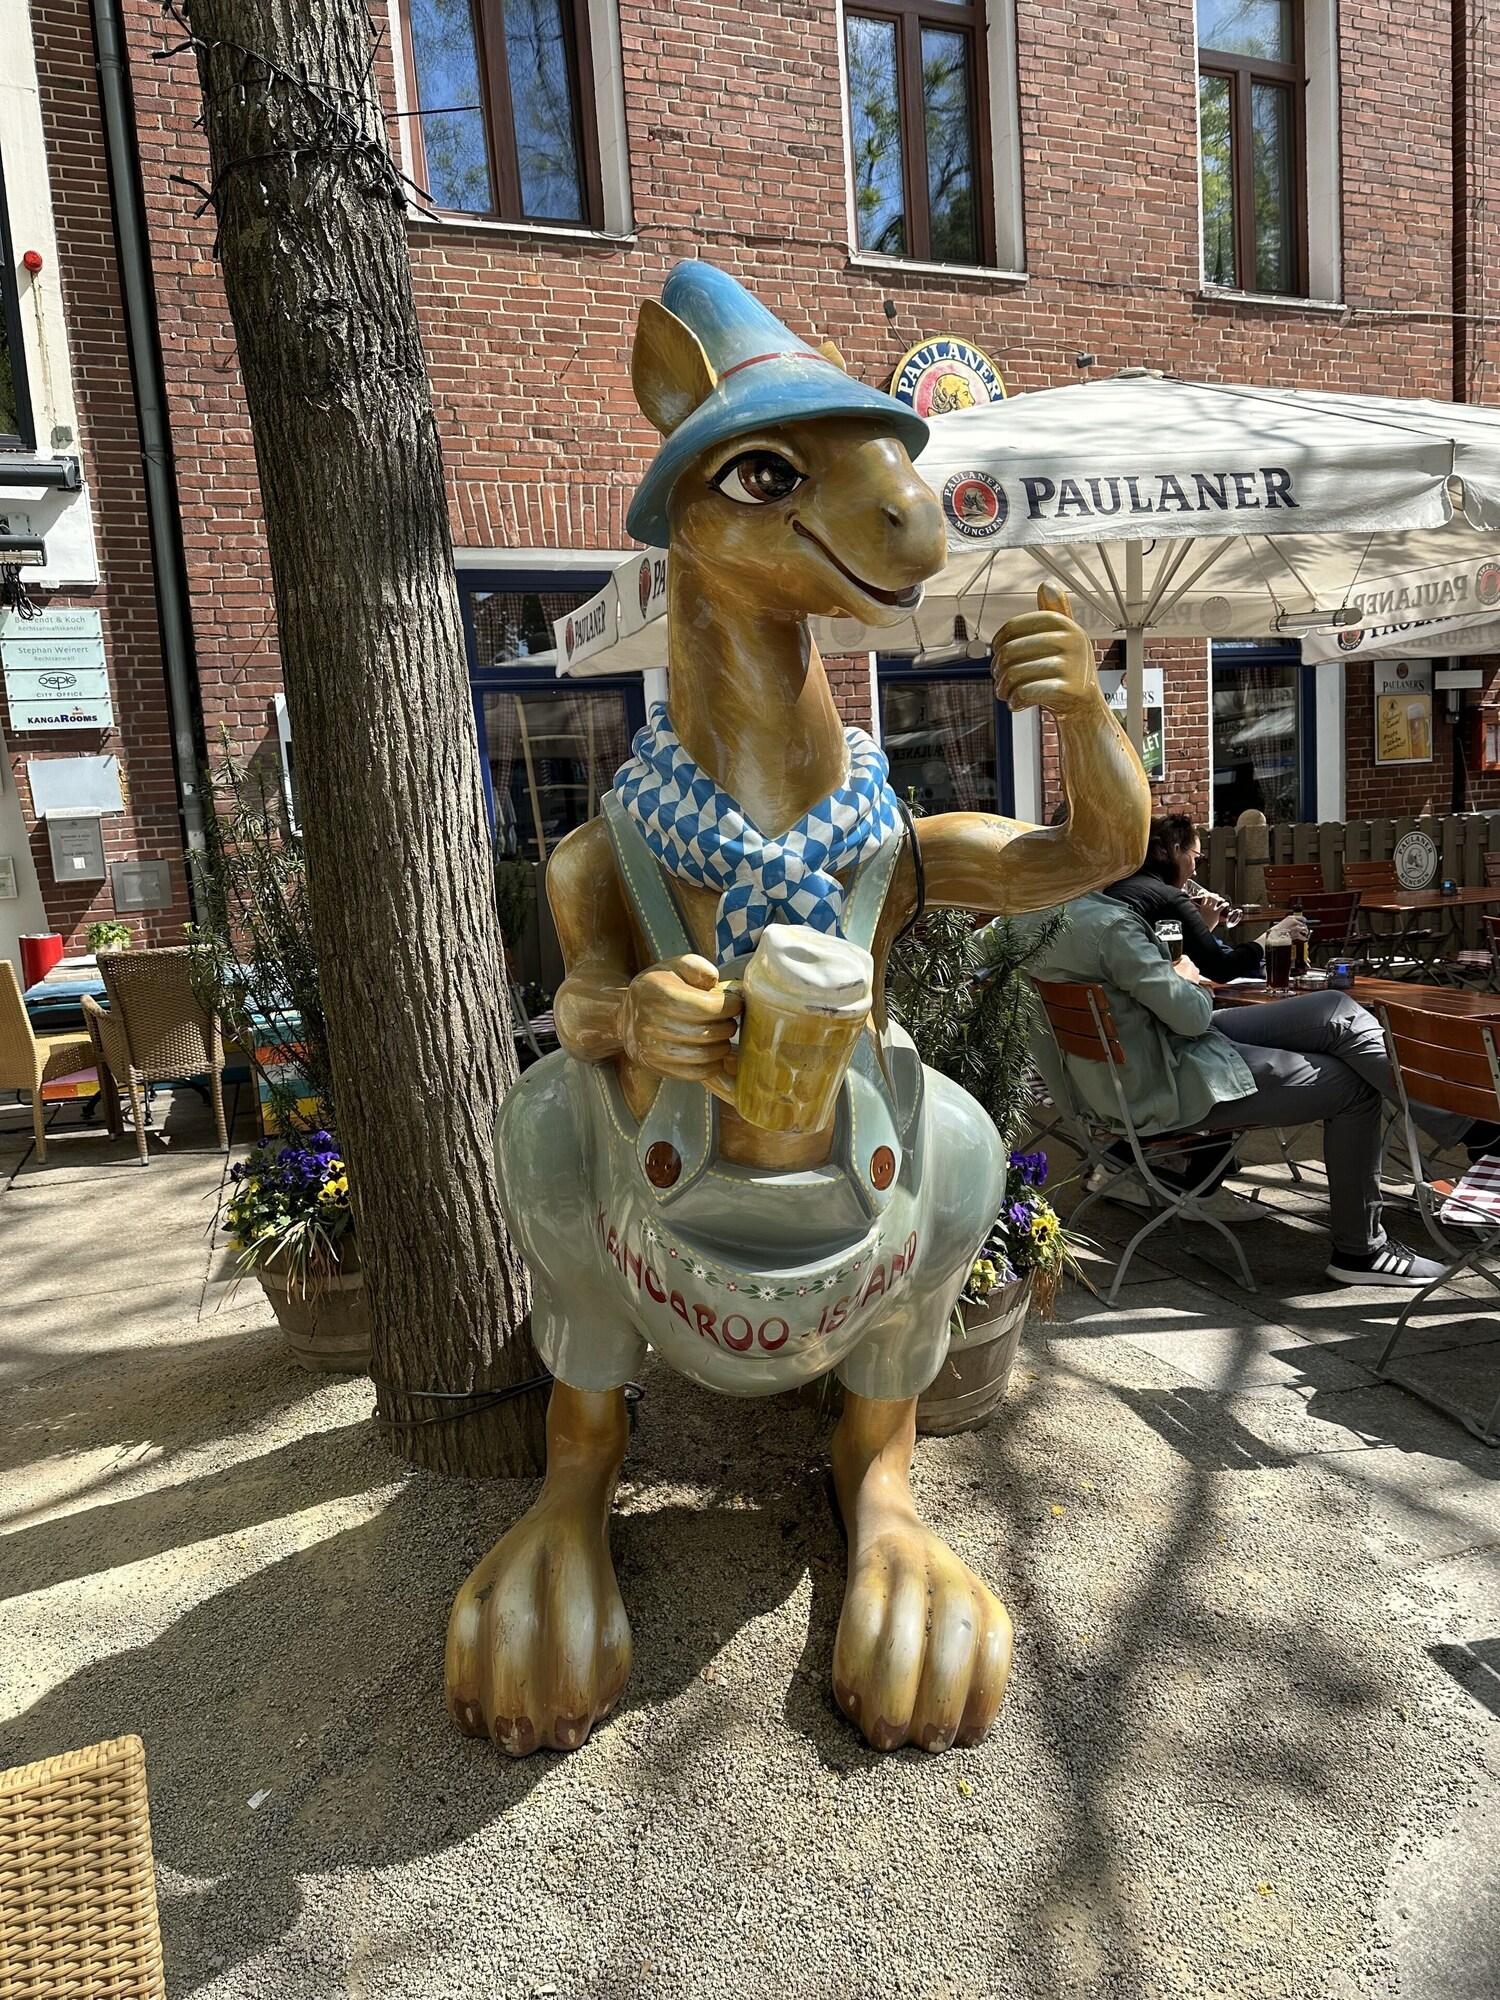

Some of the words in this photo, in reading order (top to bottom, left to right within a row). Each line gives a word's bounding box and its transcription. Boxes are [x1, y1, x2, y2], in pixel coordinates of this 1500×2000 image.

[898, 342, 1001, 399] PAULANER
[944, 471, 1001, 497] PAULANER
[1019, 467, 1300, 519] PAULANER
[56, 616, 63, 624] &
[65, 616, 86, 624] Koch
[574, 600, 606, 649] PAULANER
[18, 646, 53, 655] Stephan
[54, 646, 89, 654] Weinert
[1398, 835, 1433, 855] PAULANER
